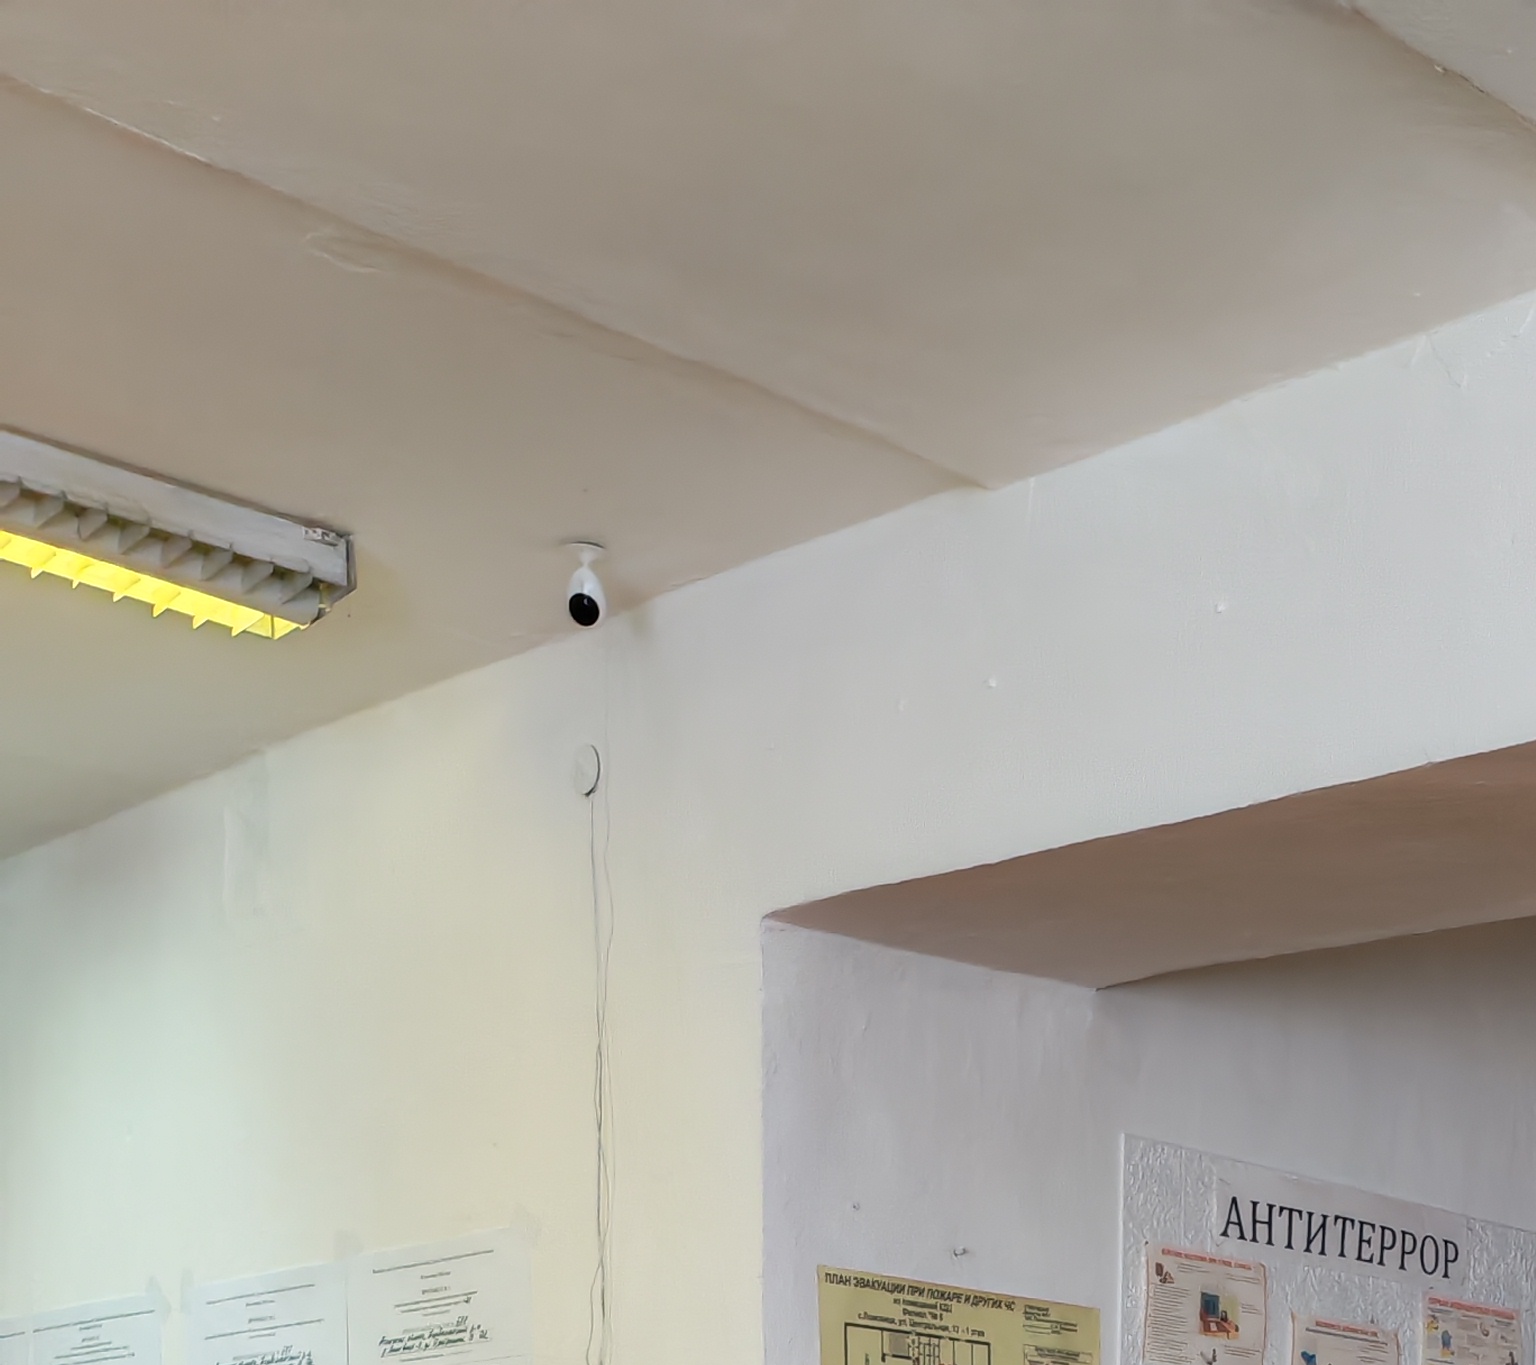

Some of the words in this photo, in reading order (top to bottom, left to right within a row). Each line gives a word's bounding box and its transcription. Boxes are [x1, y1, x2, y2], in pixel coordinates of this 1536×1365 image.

[1219, 1195, 1460, 1279] АНТИТЕРРОР
[825, 1271, 852, 1287] ПЛАН
[853, 1276, 906, 1295] ЭВАКУАЦИИ
[907, 1285, 926, 1298] ПРИ
[926, 1288, 964, 1304] ПОЖАРЕ
[963, 1294, 971, 1304] И
[970, 1295, 1003, 1310] ДРУГИХ
[1004, 1301, 1016, 1312] ЧС
